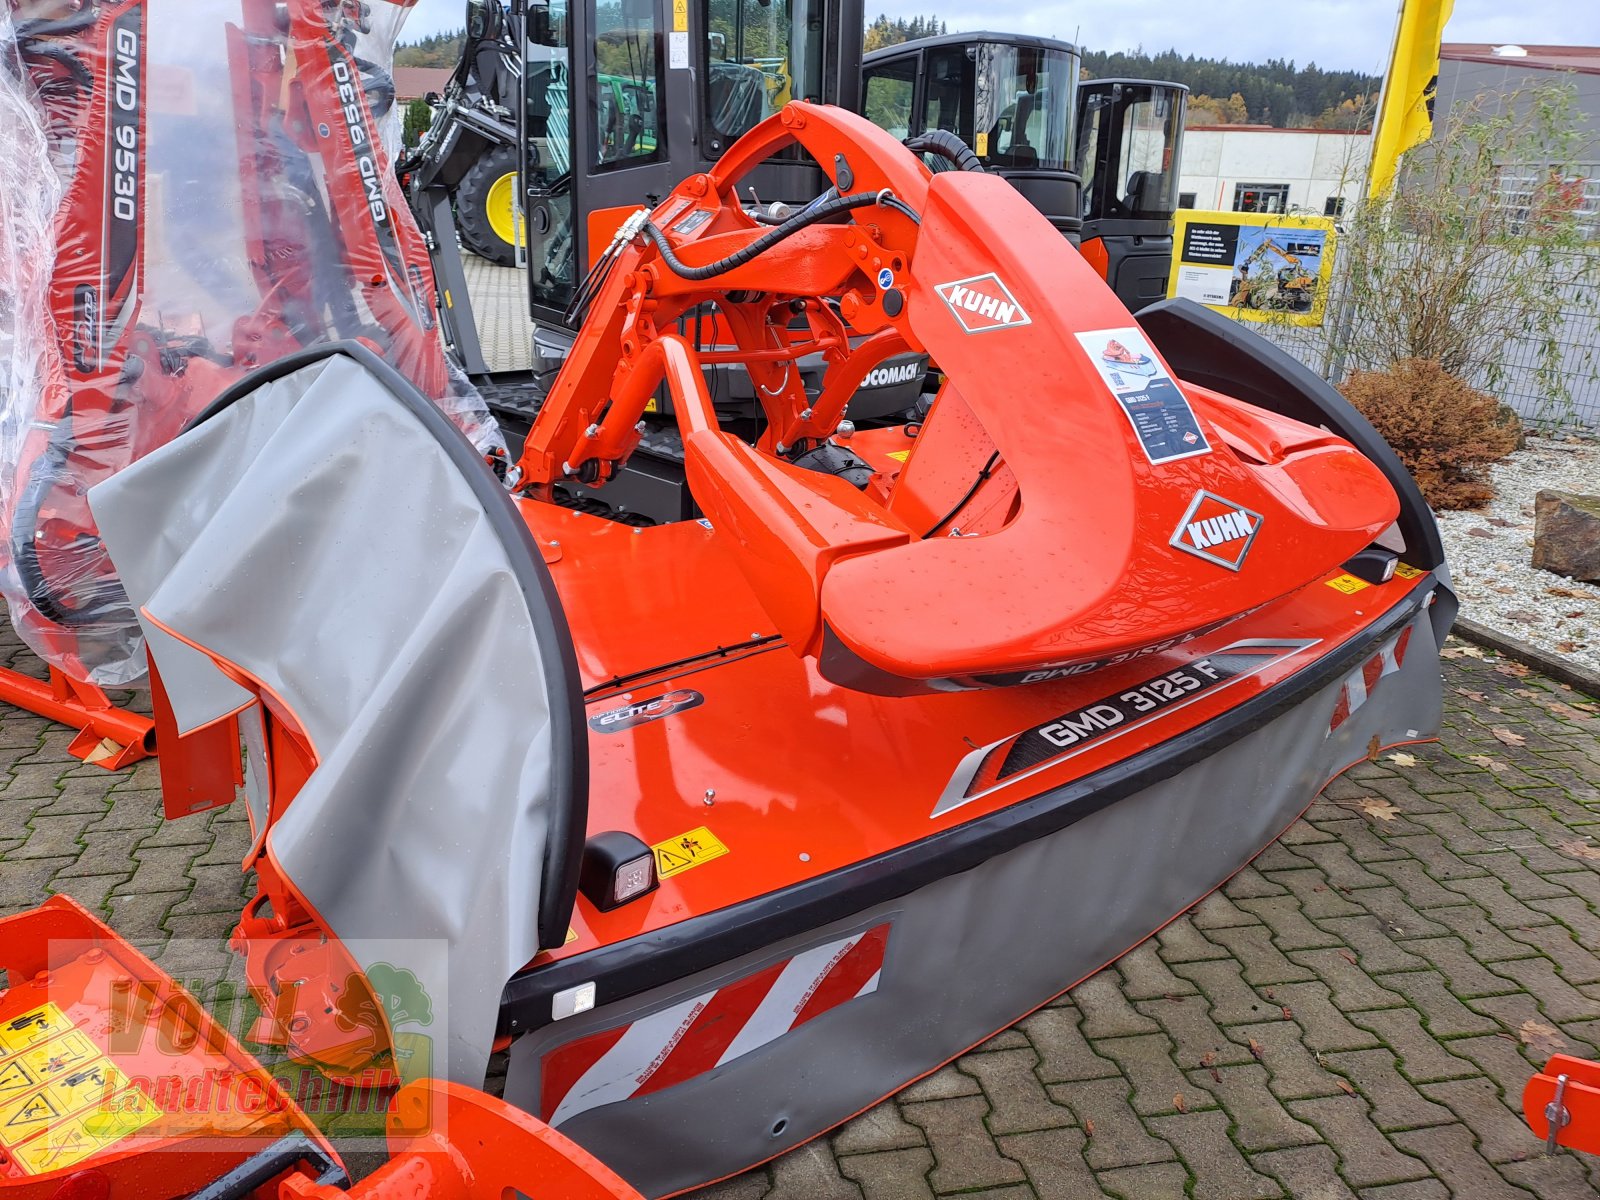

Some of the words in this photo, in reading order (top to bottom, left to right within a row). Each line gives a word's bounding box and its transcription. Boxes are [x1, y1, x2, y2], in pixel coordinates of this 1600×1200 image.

[116, 27, 137, 111] GMD
[333, 62, 365, 145] 9530
[114, 125, 137, 221] 9530
[359, 156, 387, 222] GMD
[948, 285, 1016, 324] KUHN
[1187, 509, 1254, 550] KUHN
[600, 700, 662, 726] ELITE
[1039, 705, 1124, 747] GMD
[1120, 671, 1201, 712] 3125
[1192, 660, 1219, 680] F
